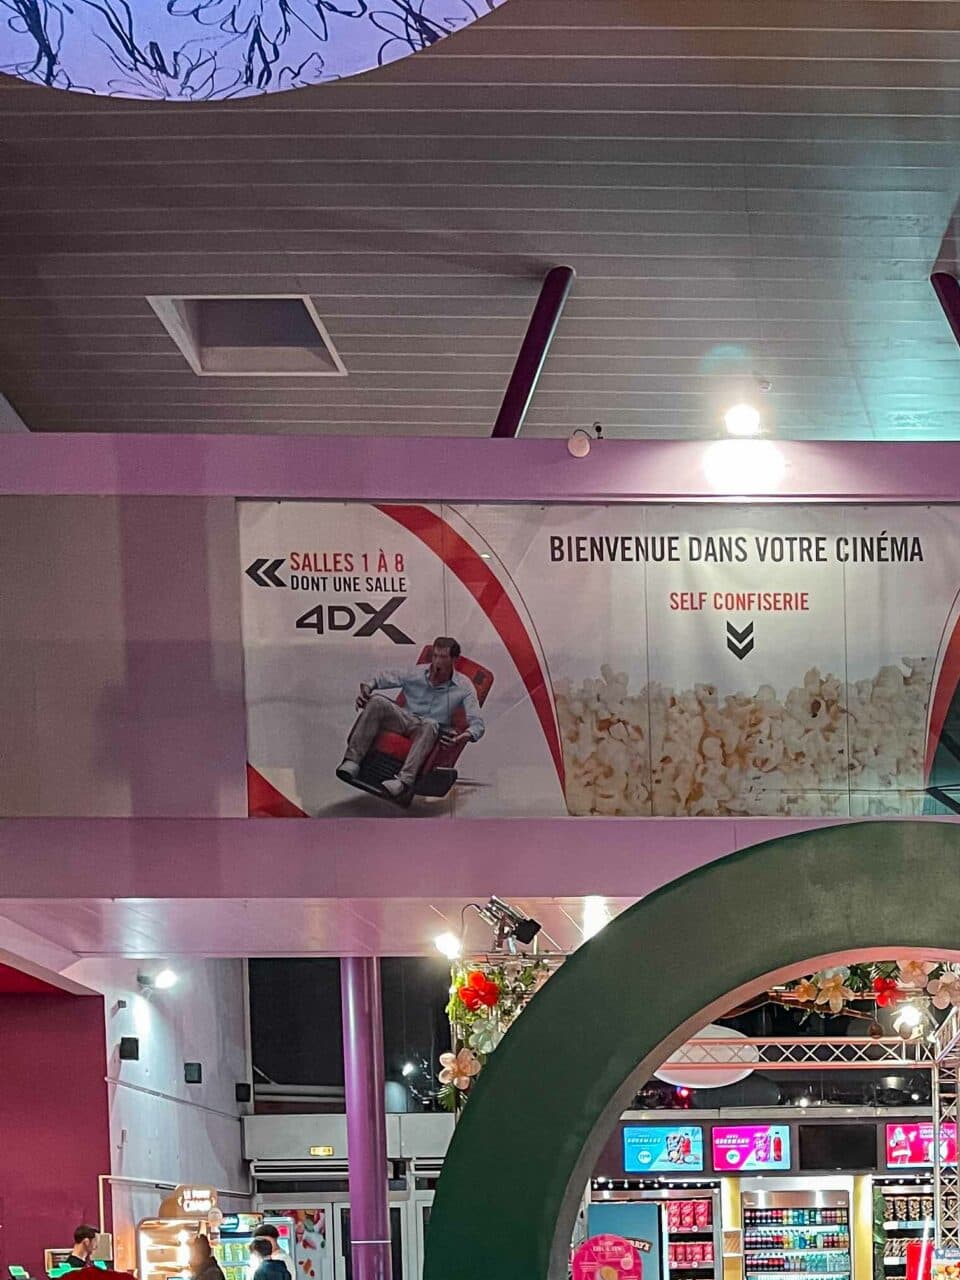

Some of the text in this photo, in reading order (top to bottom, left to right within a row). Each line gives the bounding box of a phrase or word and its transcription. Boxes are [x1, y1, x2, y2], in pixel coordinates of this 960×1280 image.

[550, 530, 925, 563] BIENVENUE DANS VOTRE CINÉMA
[290, 548, 405, 573] SALLES 1 À 8
[290, 575, 407, 593] DONT UNE SALLE
[669, 592, 810, 612] SELF CONFISERIE
[295, 596, 417, 645] 4DX
